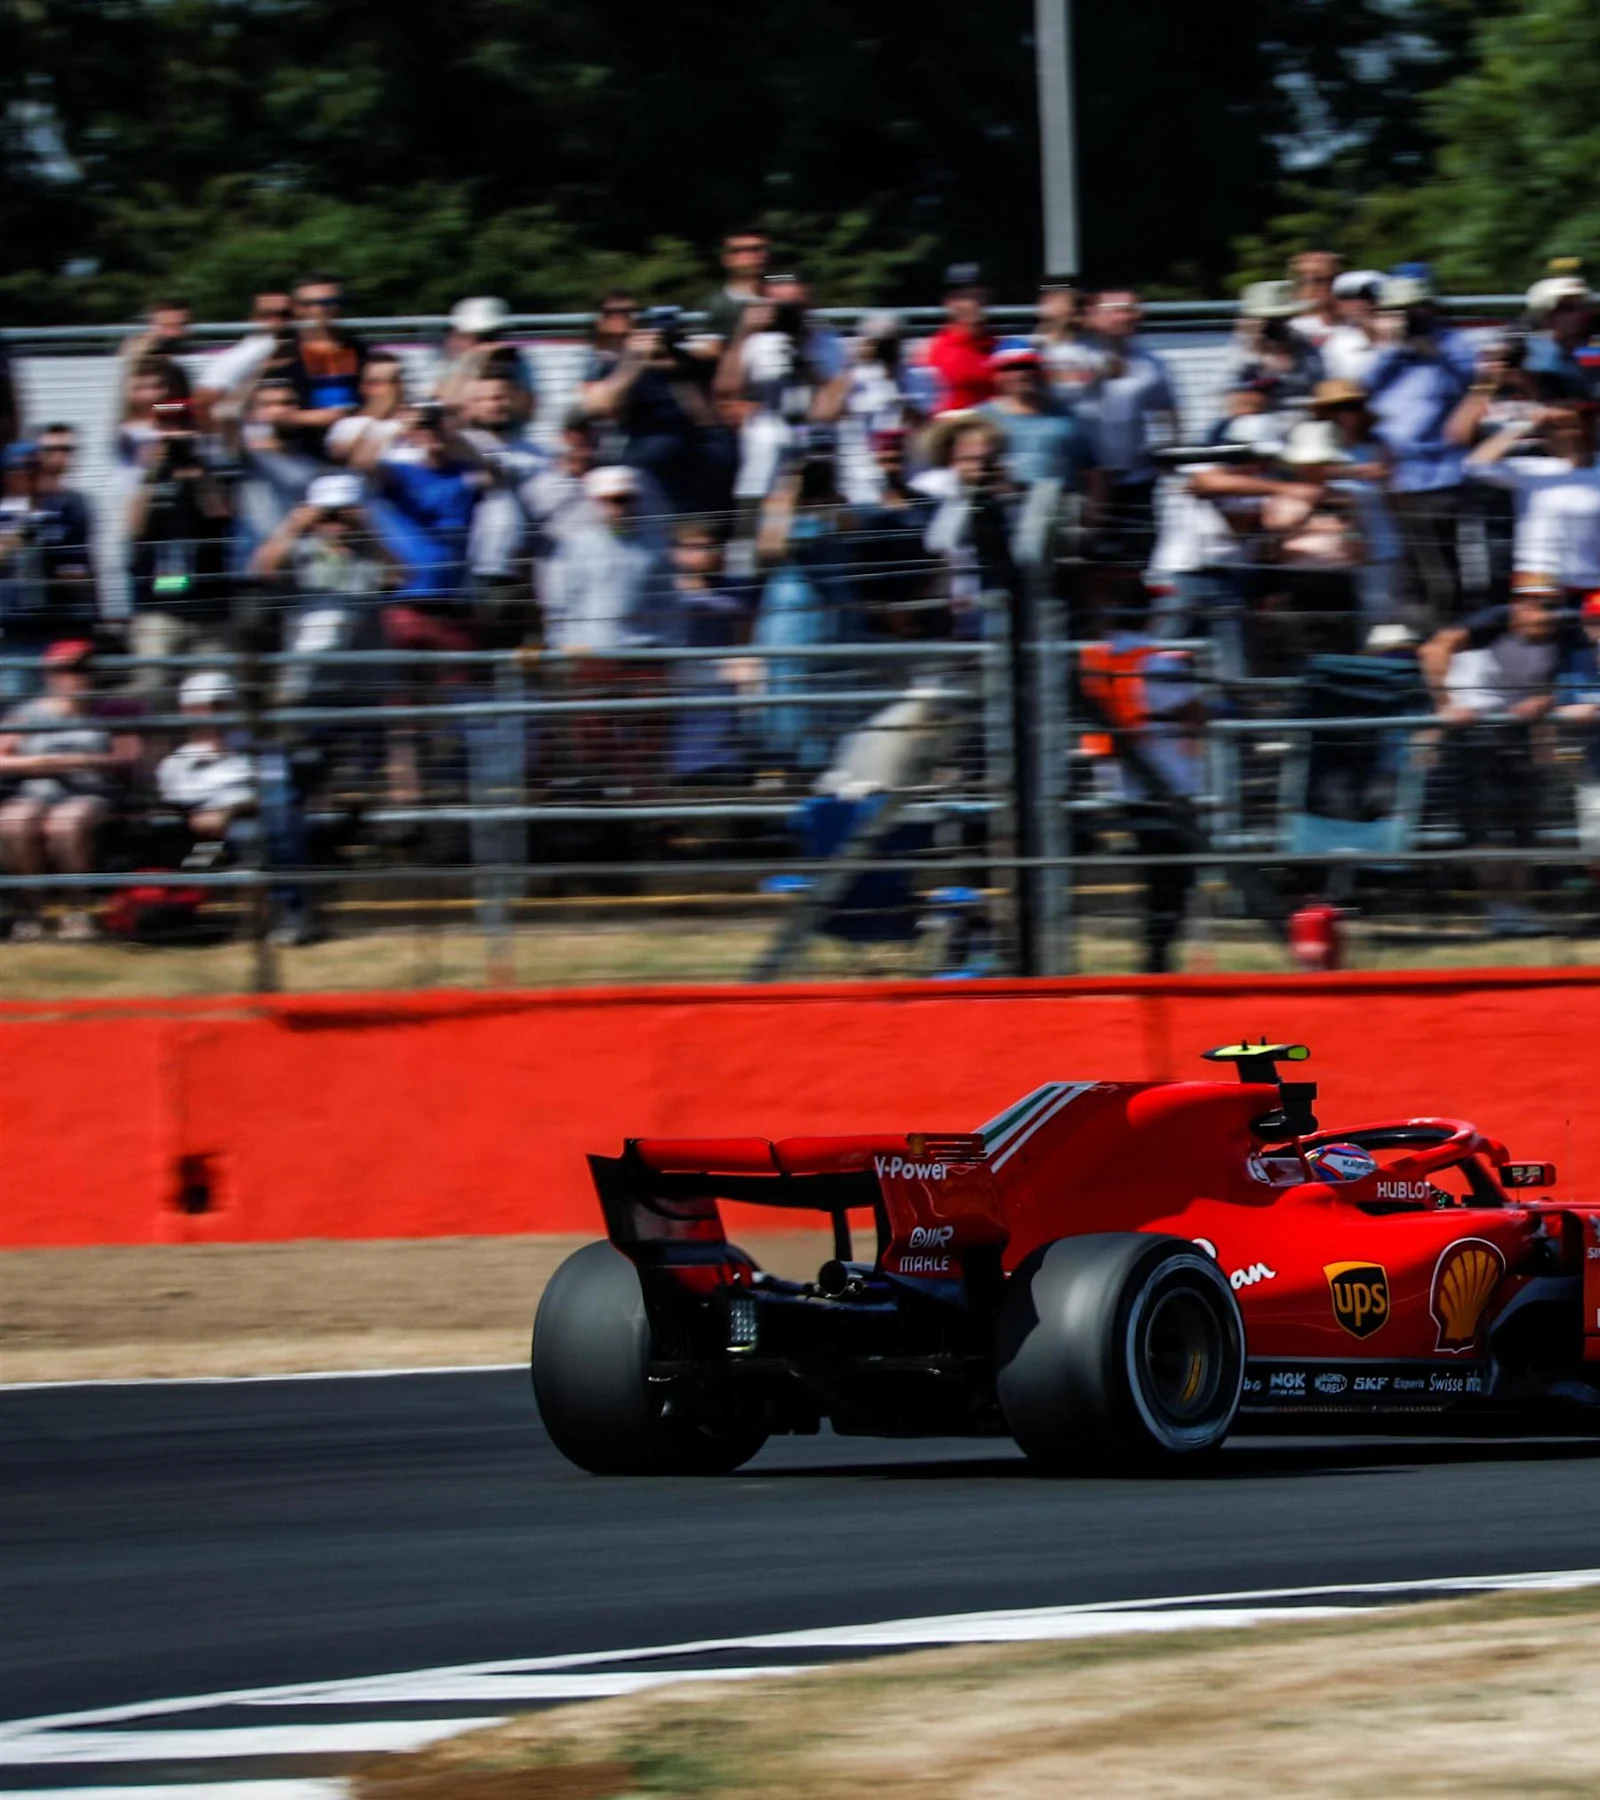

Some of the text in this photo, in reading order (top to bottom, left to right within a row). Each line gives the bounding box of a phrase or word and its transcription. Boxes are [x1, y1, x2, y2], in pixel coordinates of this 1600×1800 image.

[874, 1156, 948, 1180] V-Power
[900, 1256, 950, 1272] MAHLE
[1334, 1283, 1386, 1327] ups
[1270, 1373, 1306, 1388] NGK
[1353, 1377, 1389, 1390] SKF
[1429, 1372, 1463, 1391] Swisse
